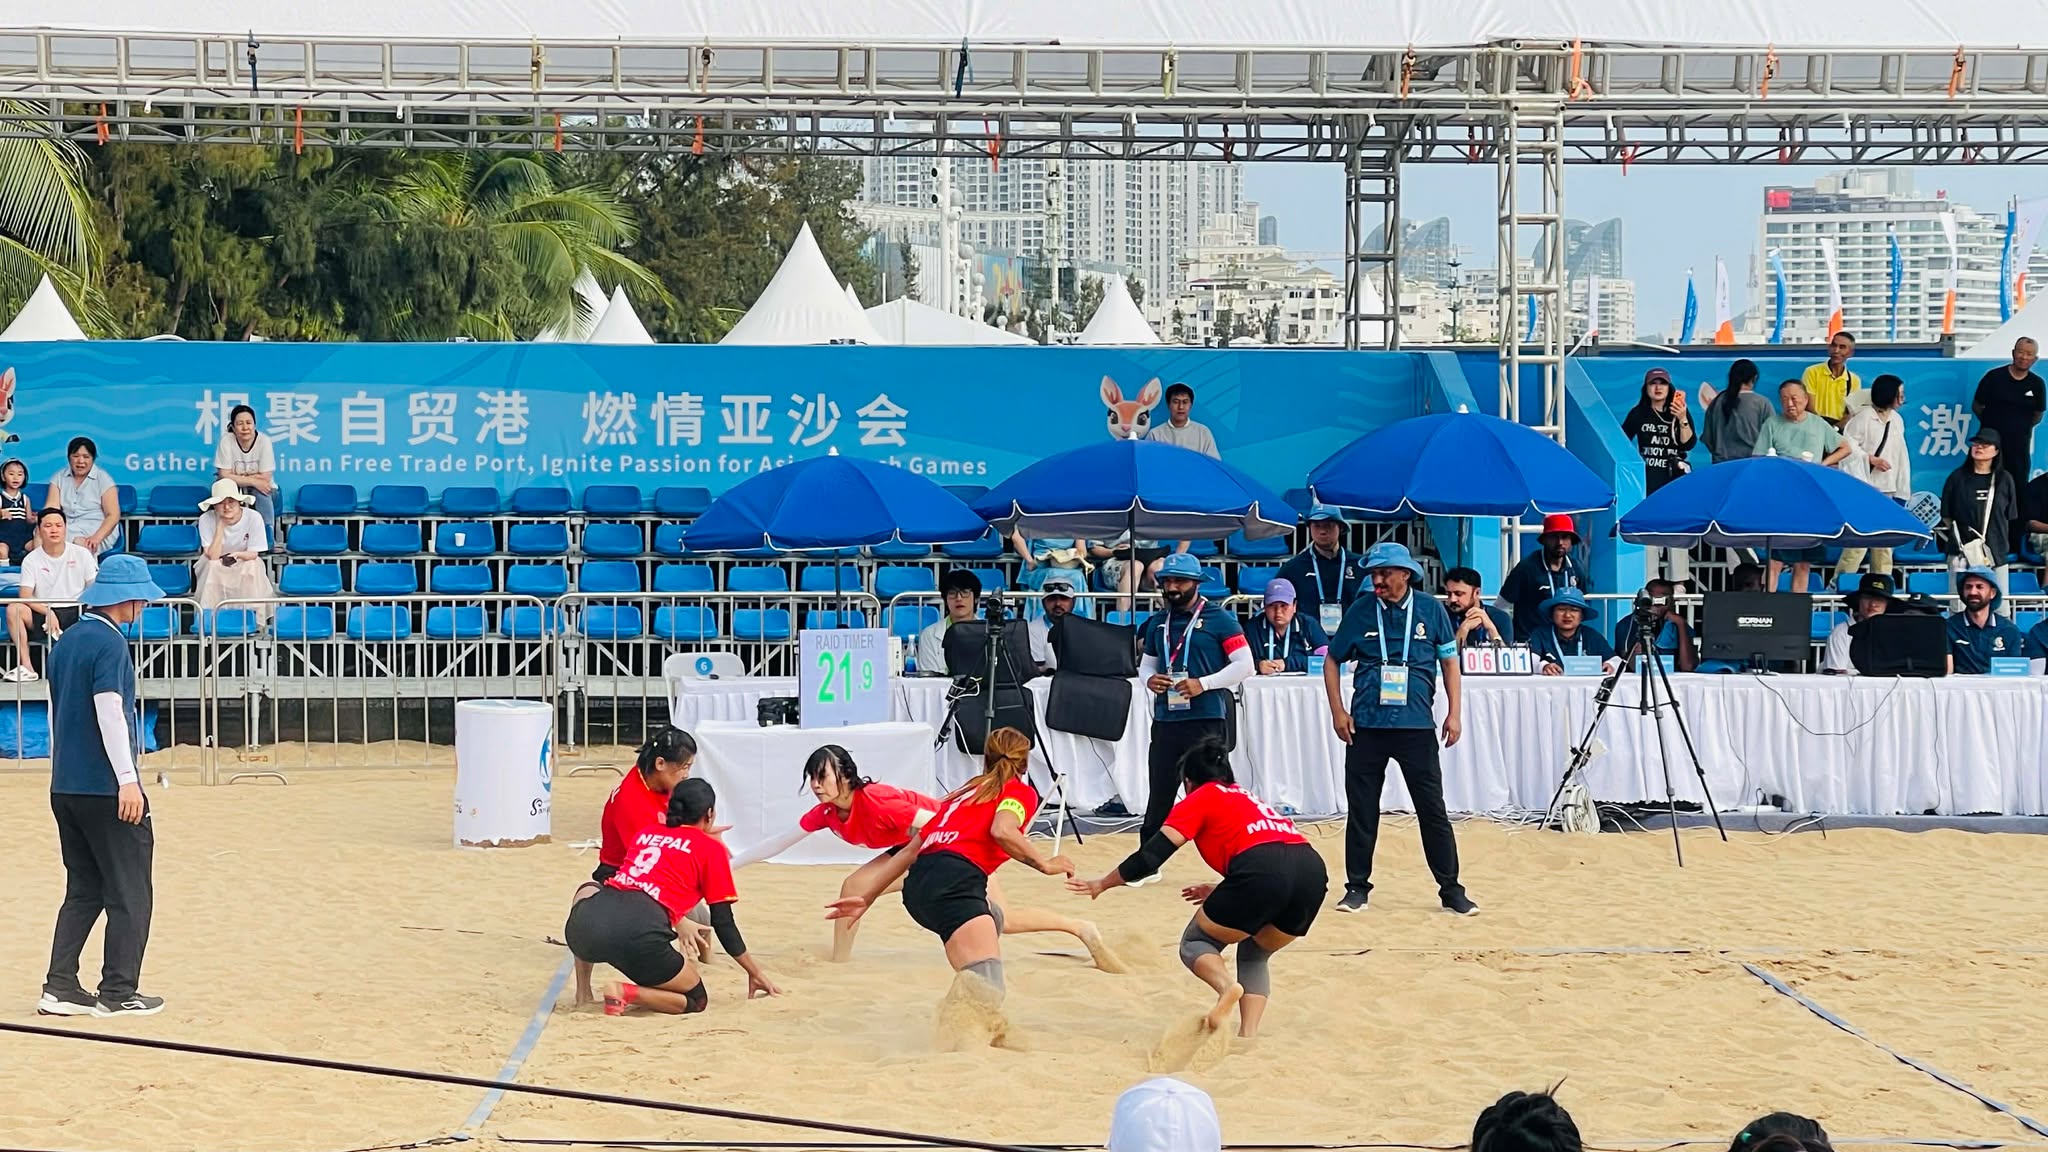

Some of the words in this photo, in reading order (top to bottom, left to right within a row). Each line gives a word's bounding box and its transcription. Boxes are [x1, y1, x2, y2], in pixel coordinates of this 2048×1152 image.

[195, 389, 530, 445] 相聚自贸港
[581, 390, 909, 447] 燃情亚沙会
[125, 453, 208, 472] Gather
[341, 455, 392, 472] Free
[400, 454, 467, 473] Trade
[475, 455, 534, 475] Port,
[542, 454, 612, 476] Ignite
[620, 455, 713, 473] Passion
[718, 454, 752, 473] for
[909, 456, 987, 475] Games
[816, 634, 840, 649] RAID
[843, 634, 874, 649] TIMER
[701, 661, 708, 671] 6
[1467, 652, 1492, 671] 06
[1502, 652, 1527, 671] 01
[816, 650, 852, 704] 21
[636, 833, 692, 854] NEPAL
[628, 846, 662, 878] 9
